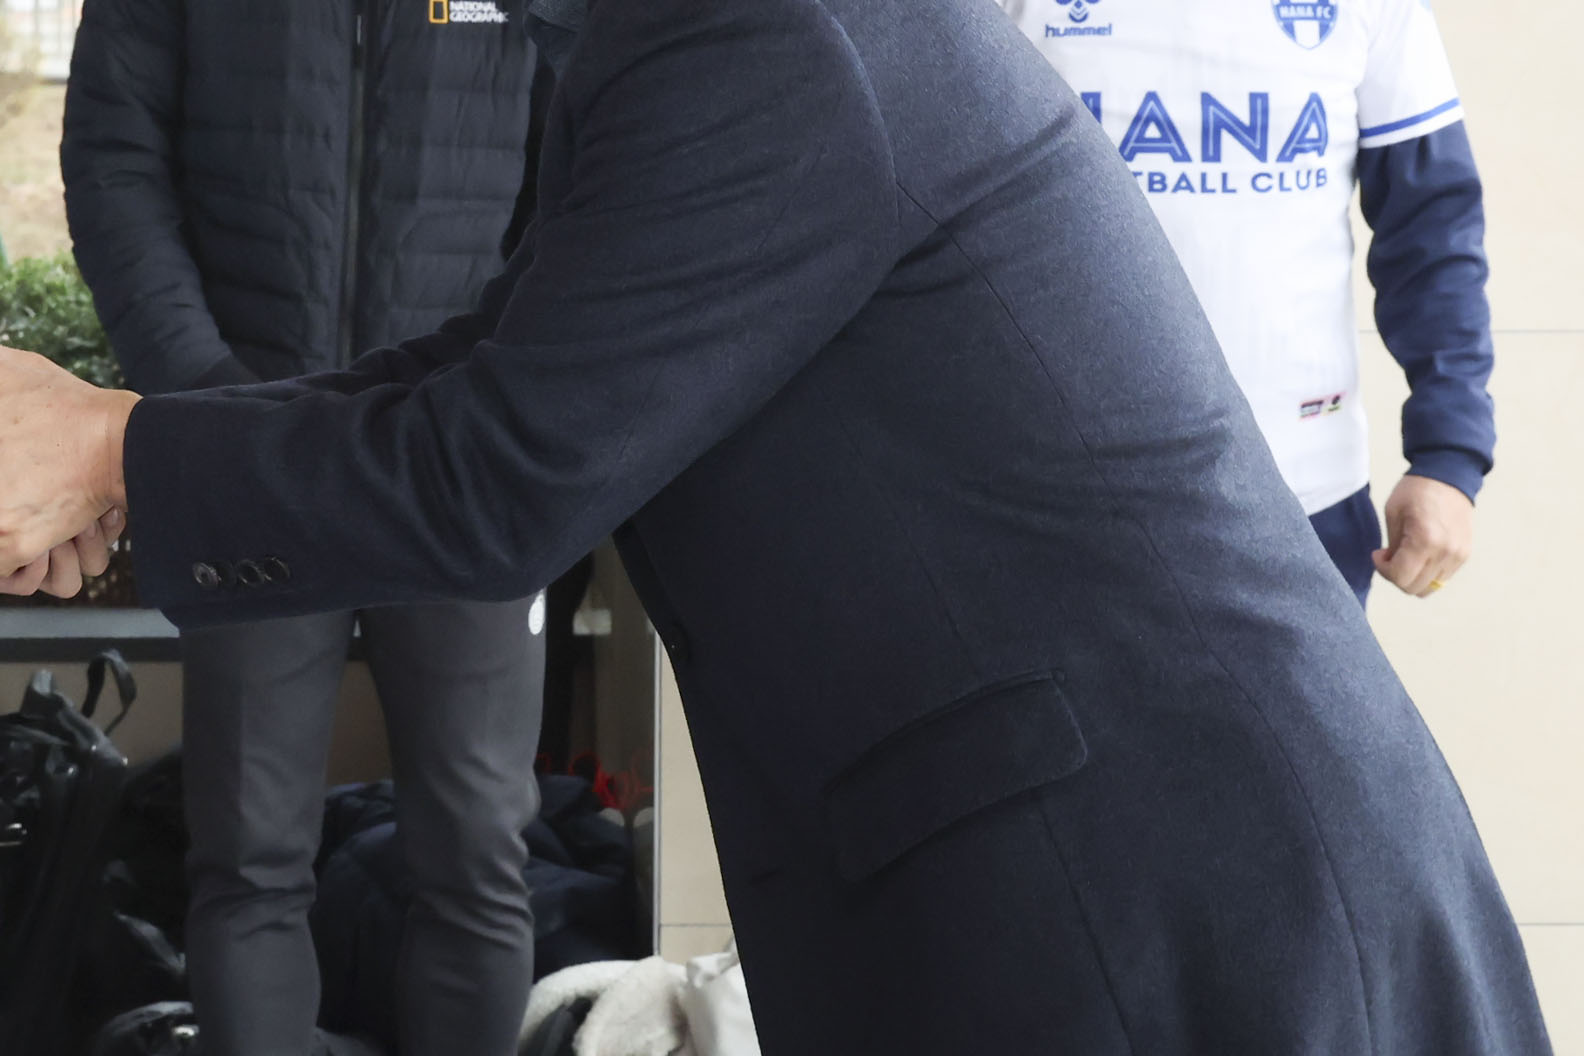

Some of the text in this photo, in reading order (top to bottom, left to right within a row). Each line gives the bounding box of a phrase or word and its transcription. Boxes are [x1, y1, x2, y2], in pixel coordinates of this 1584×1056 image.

[1045, 22, 1112, 38] hummel
[1080, 91, 1328, 163] ANA
[1251, 168, 1328, 193] CLUB
